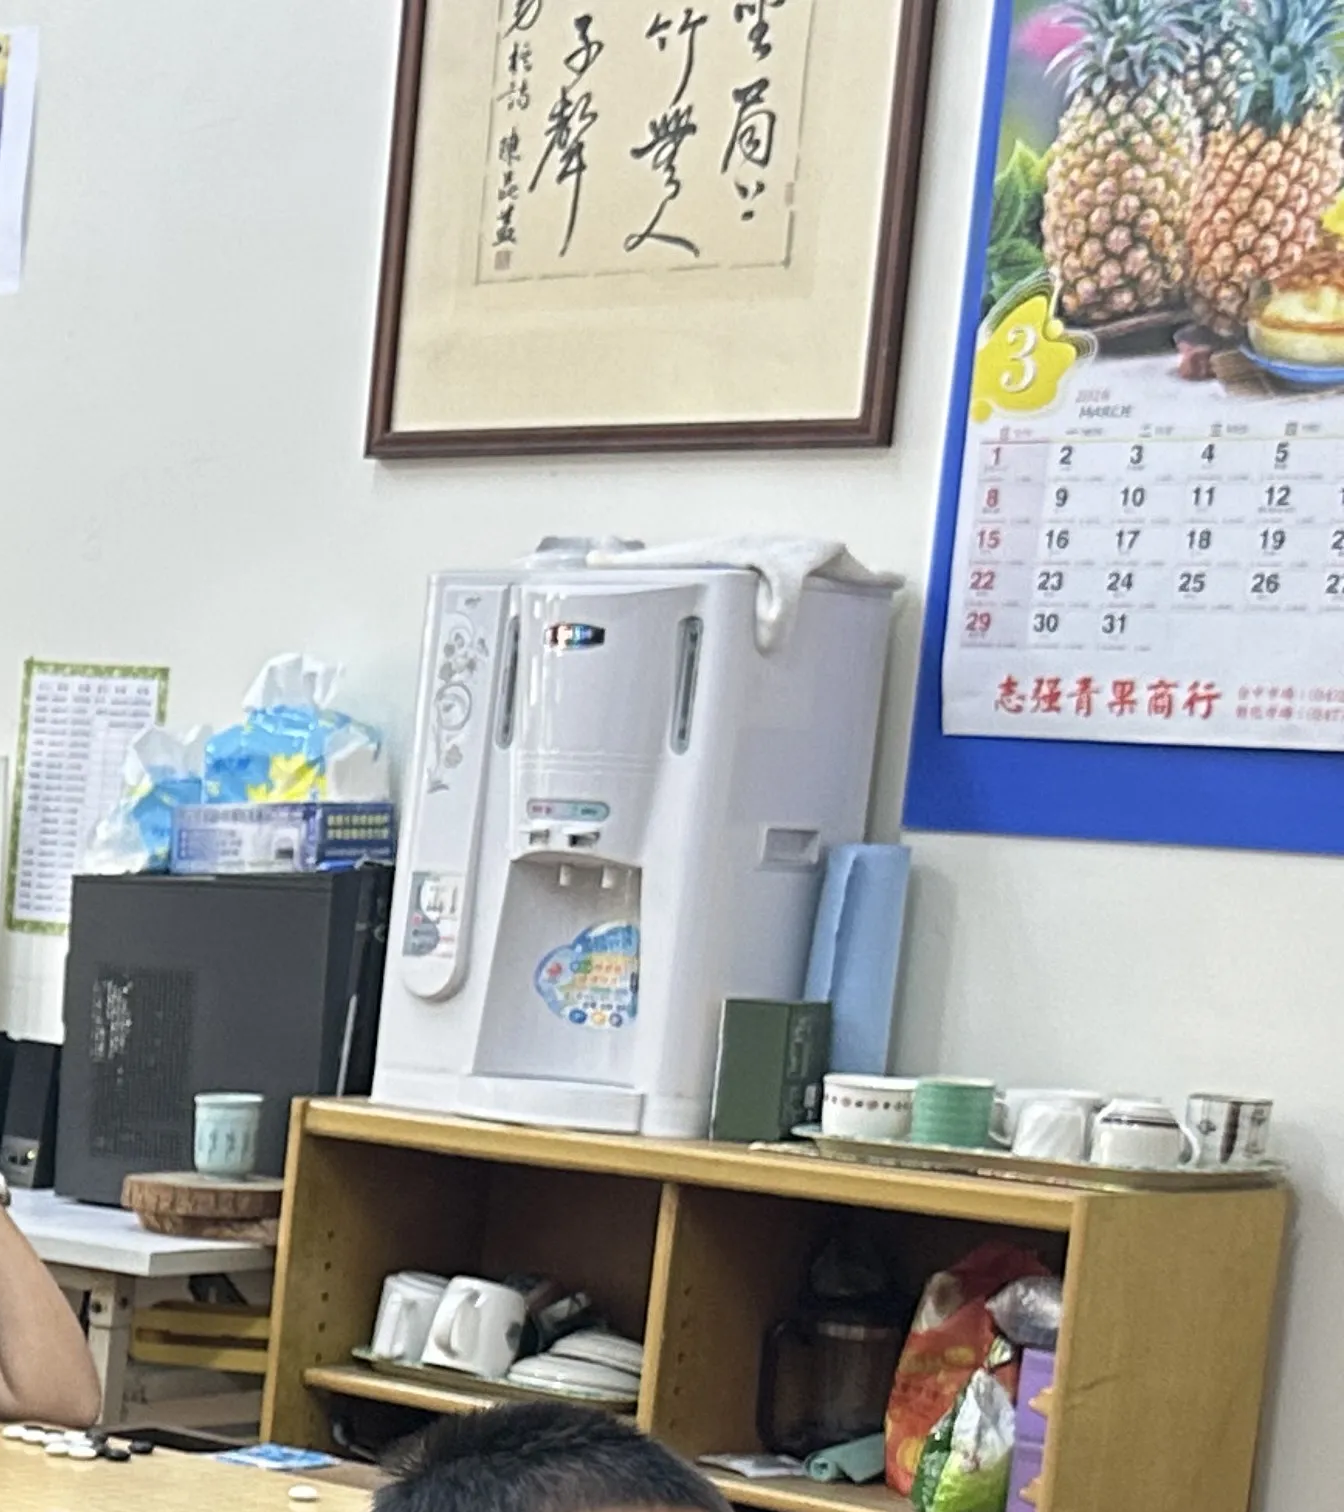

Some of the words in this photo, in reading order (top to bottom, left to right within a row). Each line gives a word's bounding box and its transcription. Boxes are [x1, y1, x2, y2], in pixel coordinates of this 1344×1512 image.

[1000, 325, 1037, 395] 3
[993, 447, 1002, 466] 1
[1059, 445, 1074, 465] 2
[1129, 445, 1144, 464] 3
[1201, 443, 1215, 463] 4
[1275, 441, 1290, 463] 5
[986, 488, 999, 508] 8
[1055, 487, 1069, 507] 9
[1120, 487, 1146, 508] 10
[1193, 486, 1216, 506] 11
[1265, 485, 1292, 506] 12
[977, 529, 1001, 549] 15
[1045, 529, 1070, 549] 16
[1116, 529, 1141, 550] 17
[1187, 528, 1212, 550] 18
[1260, 529, 1286, 550] 19
[969, 570, 996, 591] 22
[1037, 571, 1064, 591] 23
[1107, 572, 1134, 592] 24
[1178, 572, 1206, 593] 25
[1250, 573, 1280, 594] 26
[965, 612, 992, 632] 29
[1033, 613, 1060, 633] 30
[1101, 613, 1128, 634] 31
